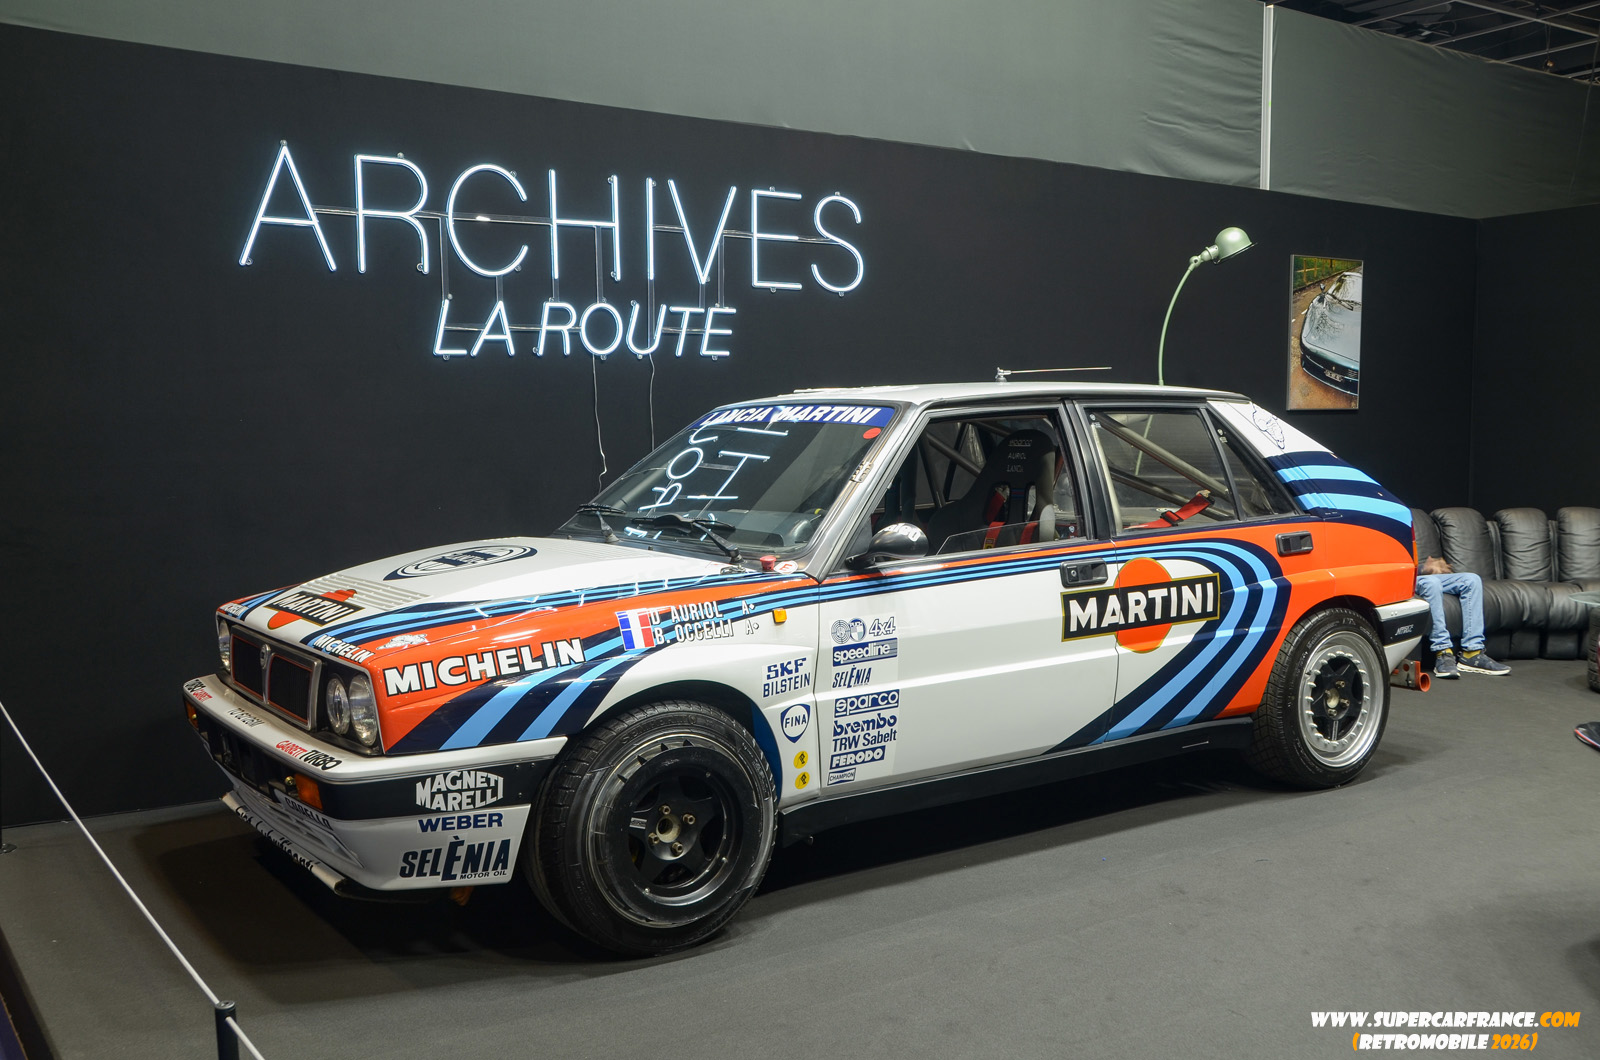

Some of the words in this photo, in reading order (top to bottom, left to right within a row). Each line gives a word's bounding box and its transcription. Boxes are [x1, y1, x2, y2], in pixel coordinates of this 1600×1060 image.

[238, 142, 864, 294] ARCHIVES
[434, 300, 515, 357] LA
[537, 300, 736, 357] ROUTE
[700, 407, 774, 426] LANCIA
[777, 405, 881, 423] MARTINI
[273, 594, 355, 622] MARTINI
[671, 601, 723, 623] AURIOL
[1069, 581, 1214, 632] MARTINI
[674, 619, 734, 643] OCCELLI
[869, 616, 896, 637] 4x4
[313, 634, 375, 664] MICHELIN
[833, 643, 890, 664] speedline
[382, 637, 587, 697] MICHELIN
[766, 657, 807, 680] SKF
[763, 672, 811, 698] BILSTEIN
[835, 691, 899, 716] sparco
[785, 714, 807, 729] FINA
[833, 713, 898, 737] brembo
[833, 735, 860, 752] TRW
[862, 728, 897, 746] Sabelt
[299, 749, 342, 770] TURBO
[832, 748, 883, 768] FERODO
[416, 770, 504, 796] MAGNETI
[829, 772, 855, 782] CHAMPION
[418, 812, 503, 832] WEBER
[399, 835, 511, 881] SELÈNIA
[460, 871, 490, 880] MOTOR
